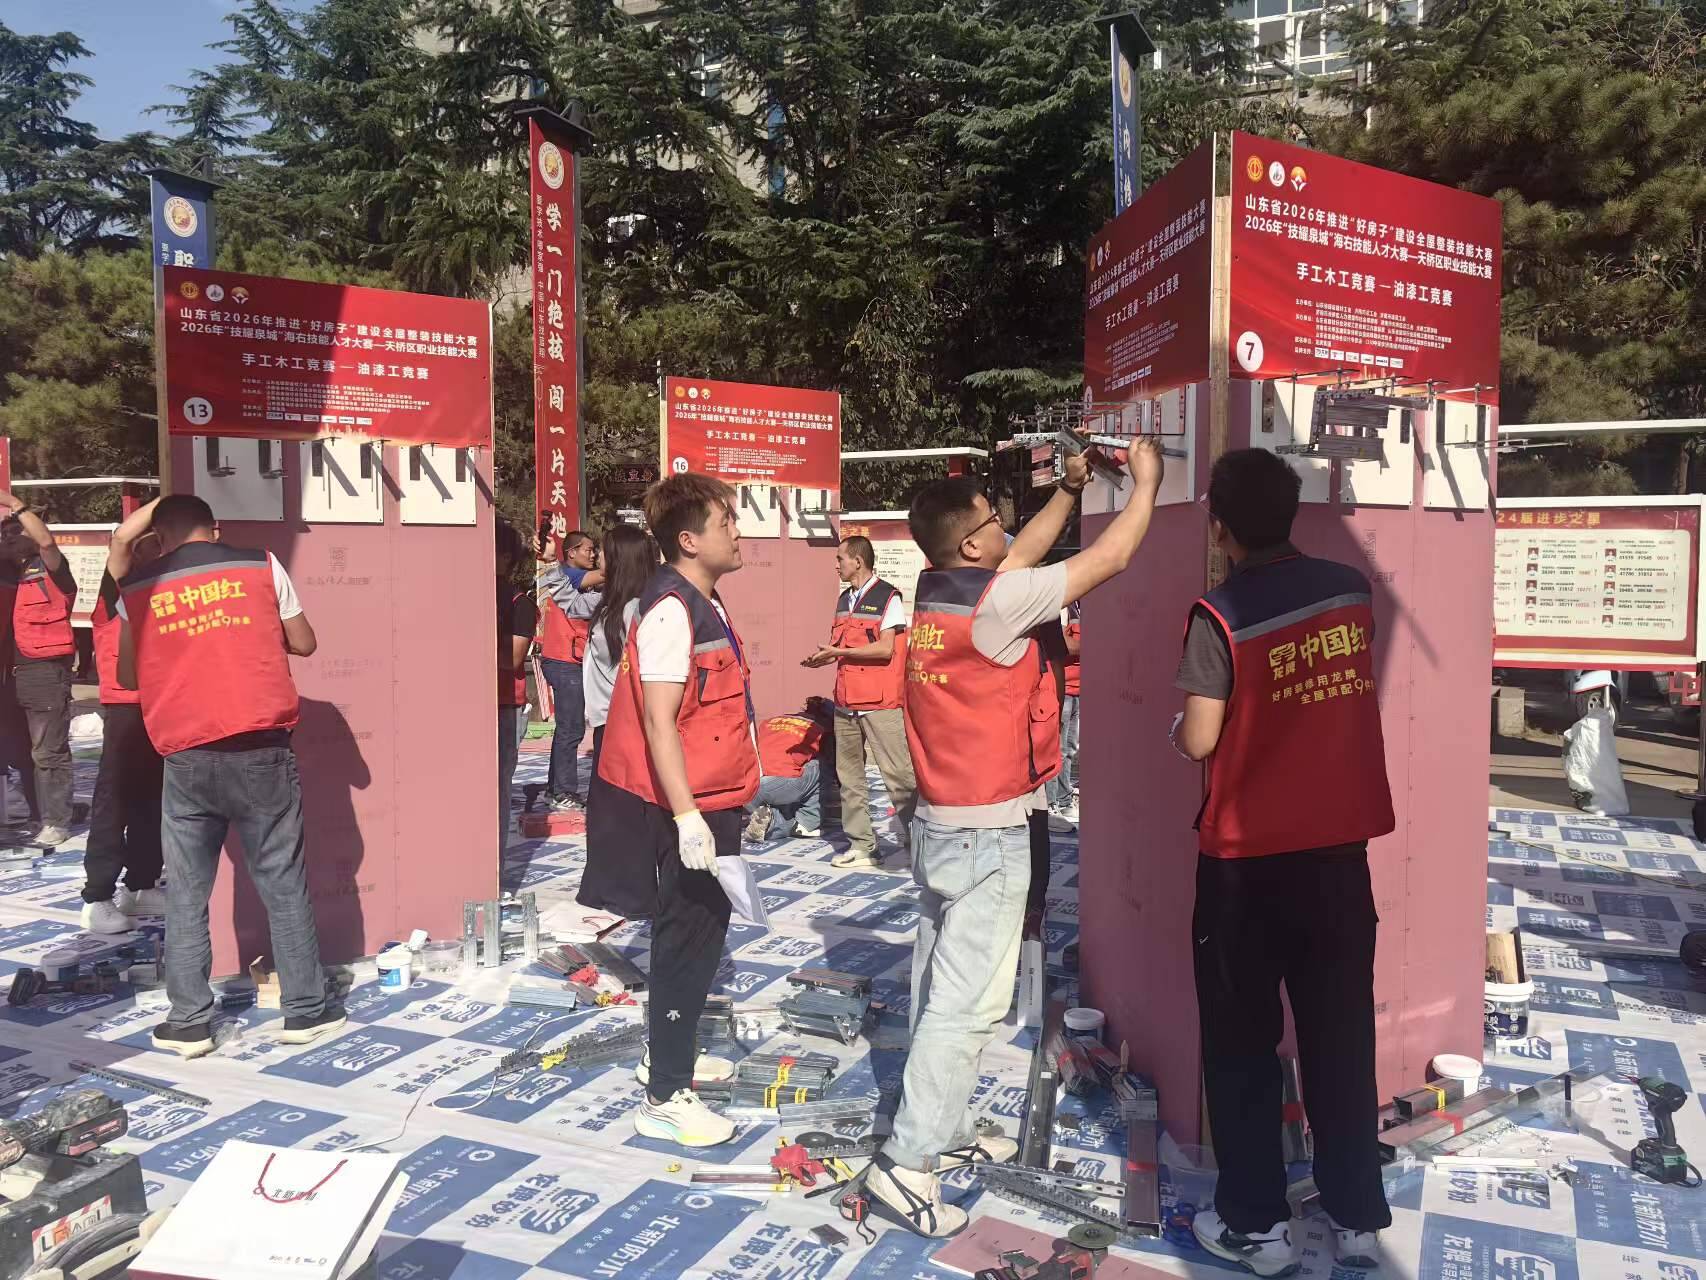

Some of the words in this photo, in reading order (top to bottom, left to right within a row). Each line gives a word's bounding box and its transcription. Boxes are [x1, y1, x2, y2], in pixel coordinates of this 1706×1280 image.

[546, 202, 564, 363] 学一门绝技
[1245, 342, 1255, 361] 7
[187, 403, 209, 419] 13
[548, 384, 567, 539] 闯一片天地
[675, 461, 686, 471] 16
[178, 578, 248, 611] 中国红
[1299, 621, 1367, 668] 中国红
[593, 1214, 681, 1278] 北新防水
